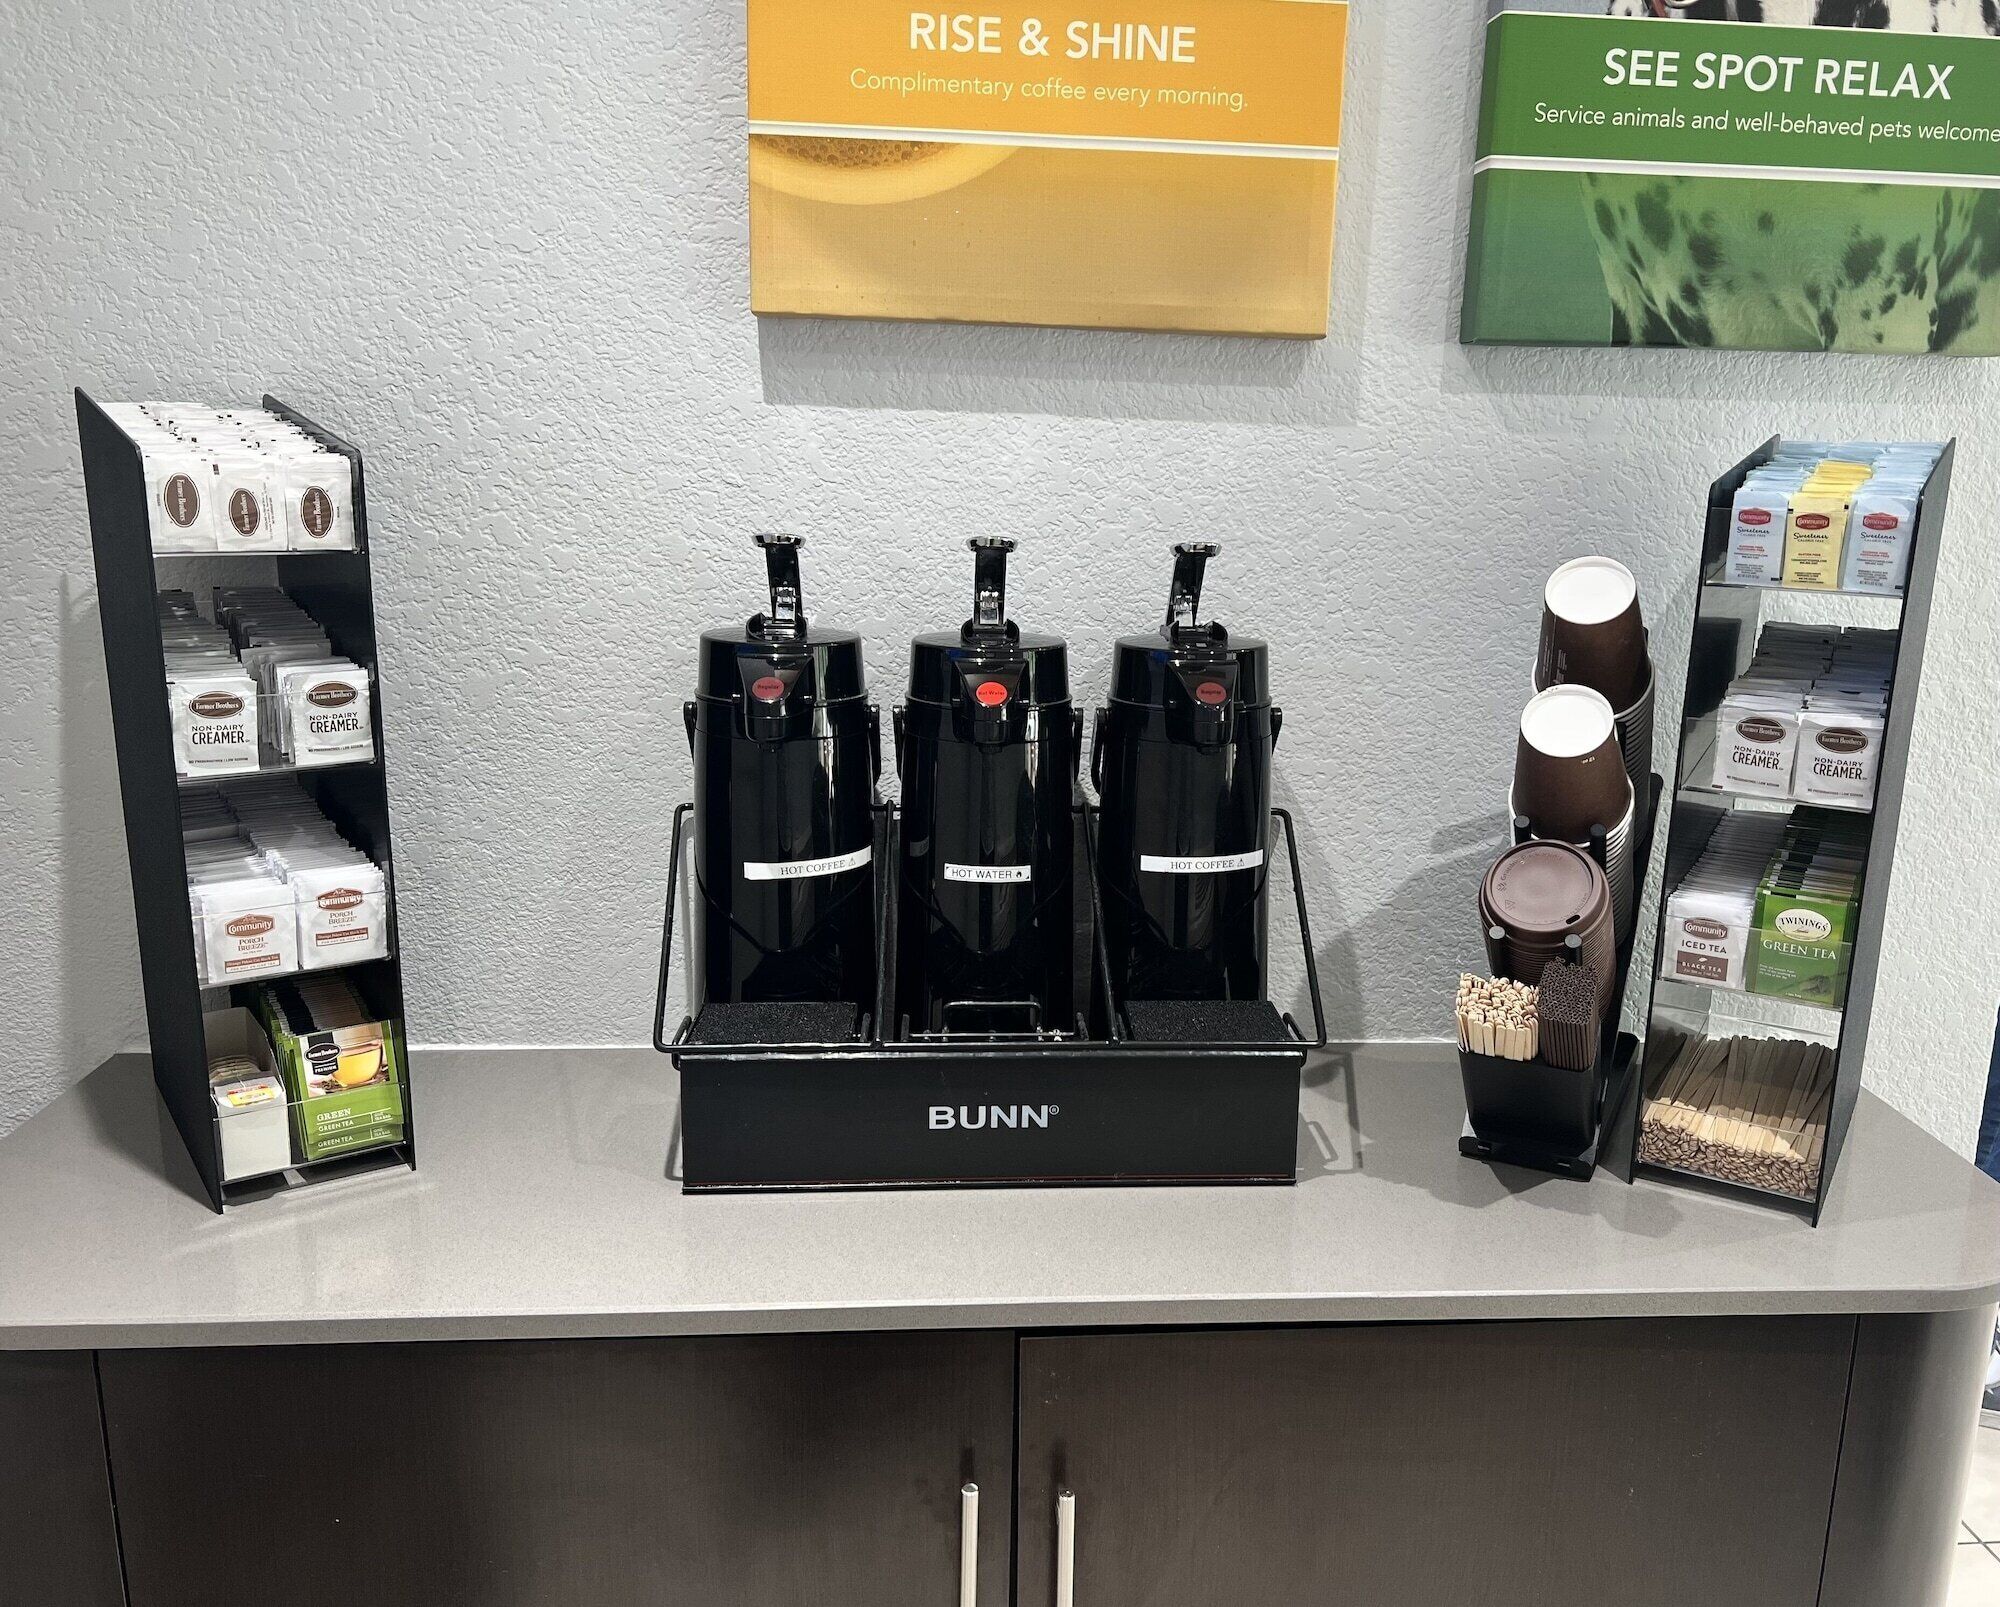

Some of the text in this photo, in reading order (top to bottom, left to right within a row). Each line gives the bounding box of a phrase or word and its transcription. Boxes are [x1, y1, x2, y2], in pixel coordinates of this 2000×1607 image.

[909, 12, 1197, 63] RISE & SHINE
[1602, 47, 1955, 100] SEE SPOT RELAX
[850, 68, 1249, 113] Complimentary coffee every morning.
[1534, 102, 1606, 126] Service
[1611, 107, 1686, 130] animals
[1691, 109, 1729, 131] and
[1734, 112, 1864, 137] well-behaved
[1868, 121, 1912, 143] pets
[1737, 526, 1770, 534] Sweetener
[1793, 532, 1829, 540] Sweetener
[1860, 531, 1897, 541] Sweetener
[215, 700, 239, 710] Brothers
[309, 712, 358, 721] NON-DAIRY
[192, 724, 244, 732] NON-DAIRY
[310, 718, 359, 733] CREAMER
[192, 731, 244, 745] CREAMER
[1734, 745, 1781, 757] NON-DAIRY
[1732, 751, 1780, 770] CREAMER
[1814, 757, 1864, 767] NON-DAIRY
[1813, 763, 1863, 780] CREAMER
[780, 859, 846, 875] HOT COFFEE
[1170, 859, 1235, 870] HOT COFFEE
[951, 869, 1012, 879] HOT WATER
[330, 910, 354, 918] PORCH
[228, 920, 272, 934] Community
[1685, 922, 1726, 937] Community
[1779, 917, 1828, 932] TWININGS
[239, 936, 264, 945] PORCH
[1681, 939, 1727, 954] ICED TEA
[1763, 939, 1837, 960] GREEN TEA
[1682, 961, 1706, 970] BLACK
[1708, 965, 1722, 973] TEA
[317, 1108, 351, 1121] GREEN
[928, 1104, 1049, 1130] BUNN
[318, 1122, 342, 1132] GREEN
[318, 1135, 354, 1148] GREEN TEA
